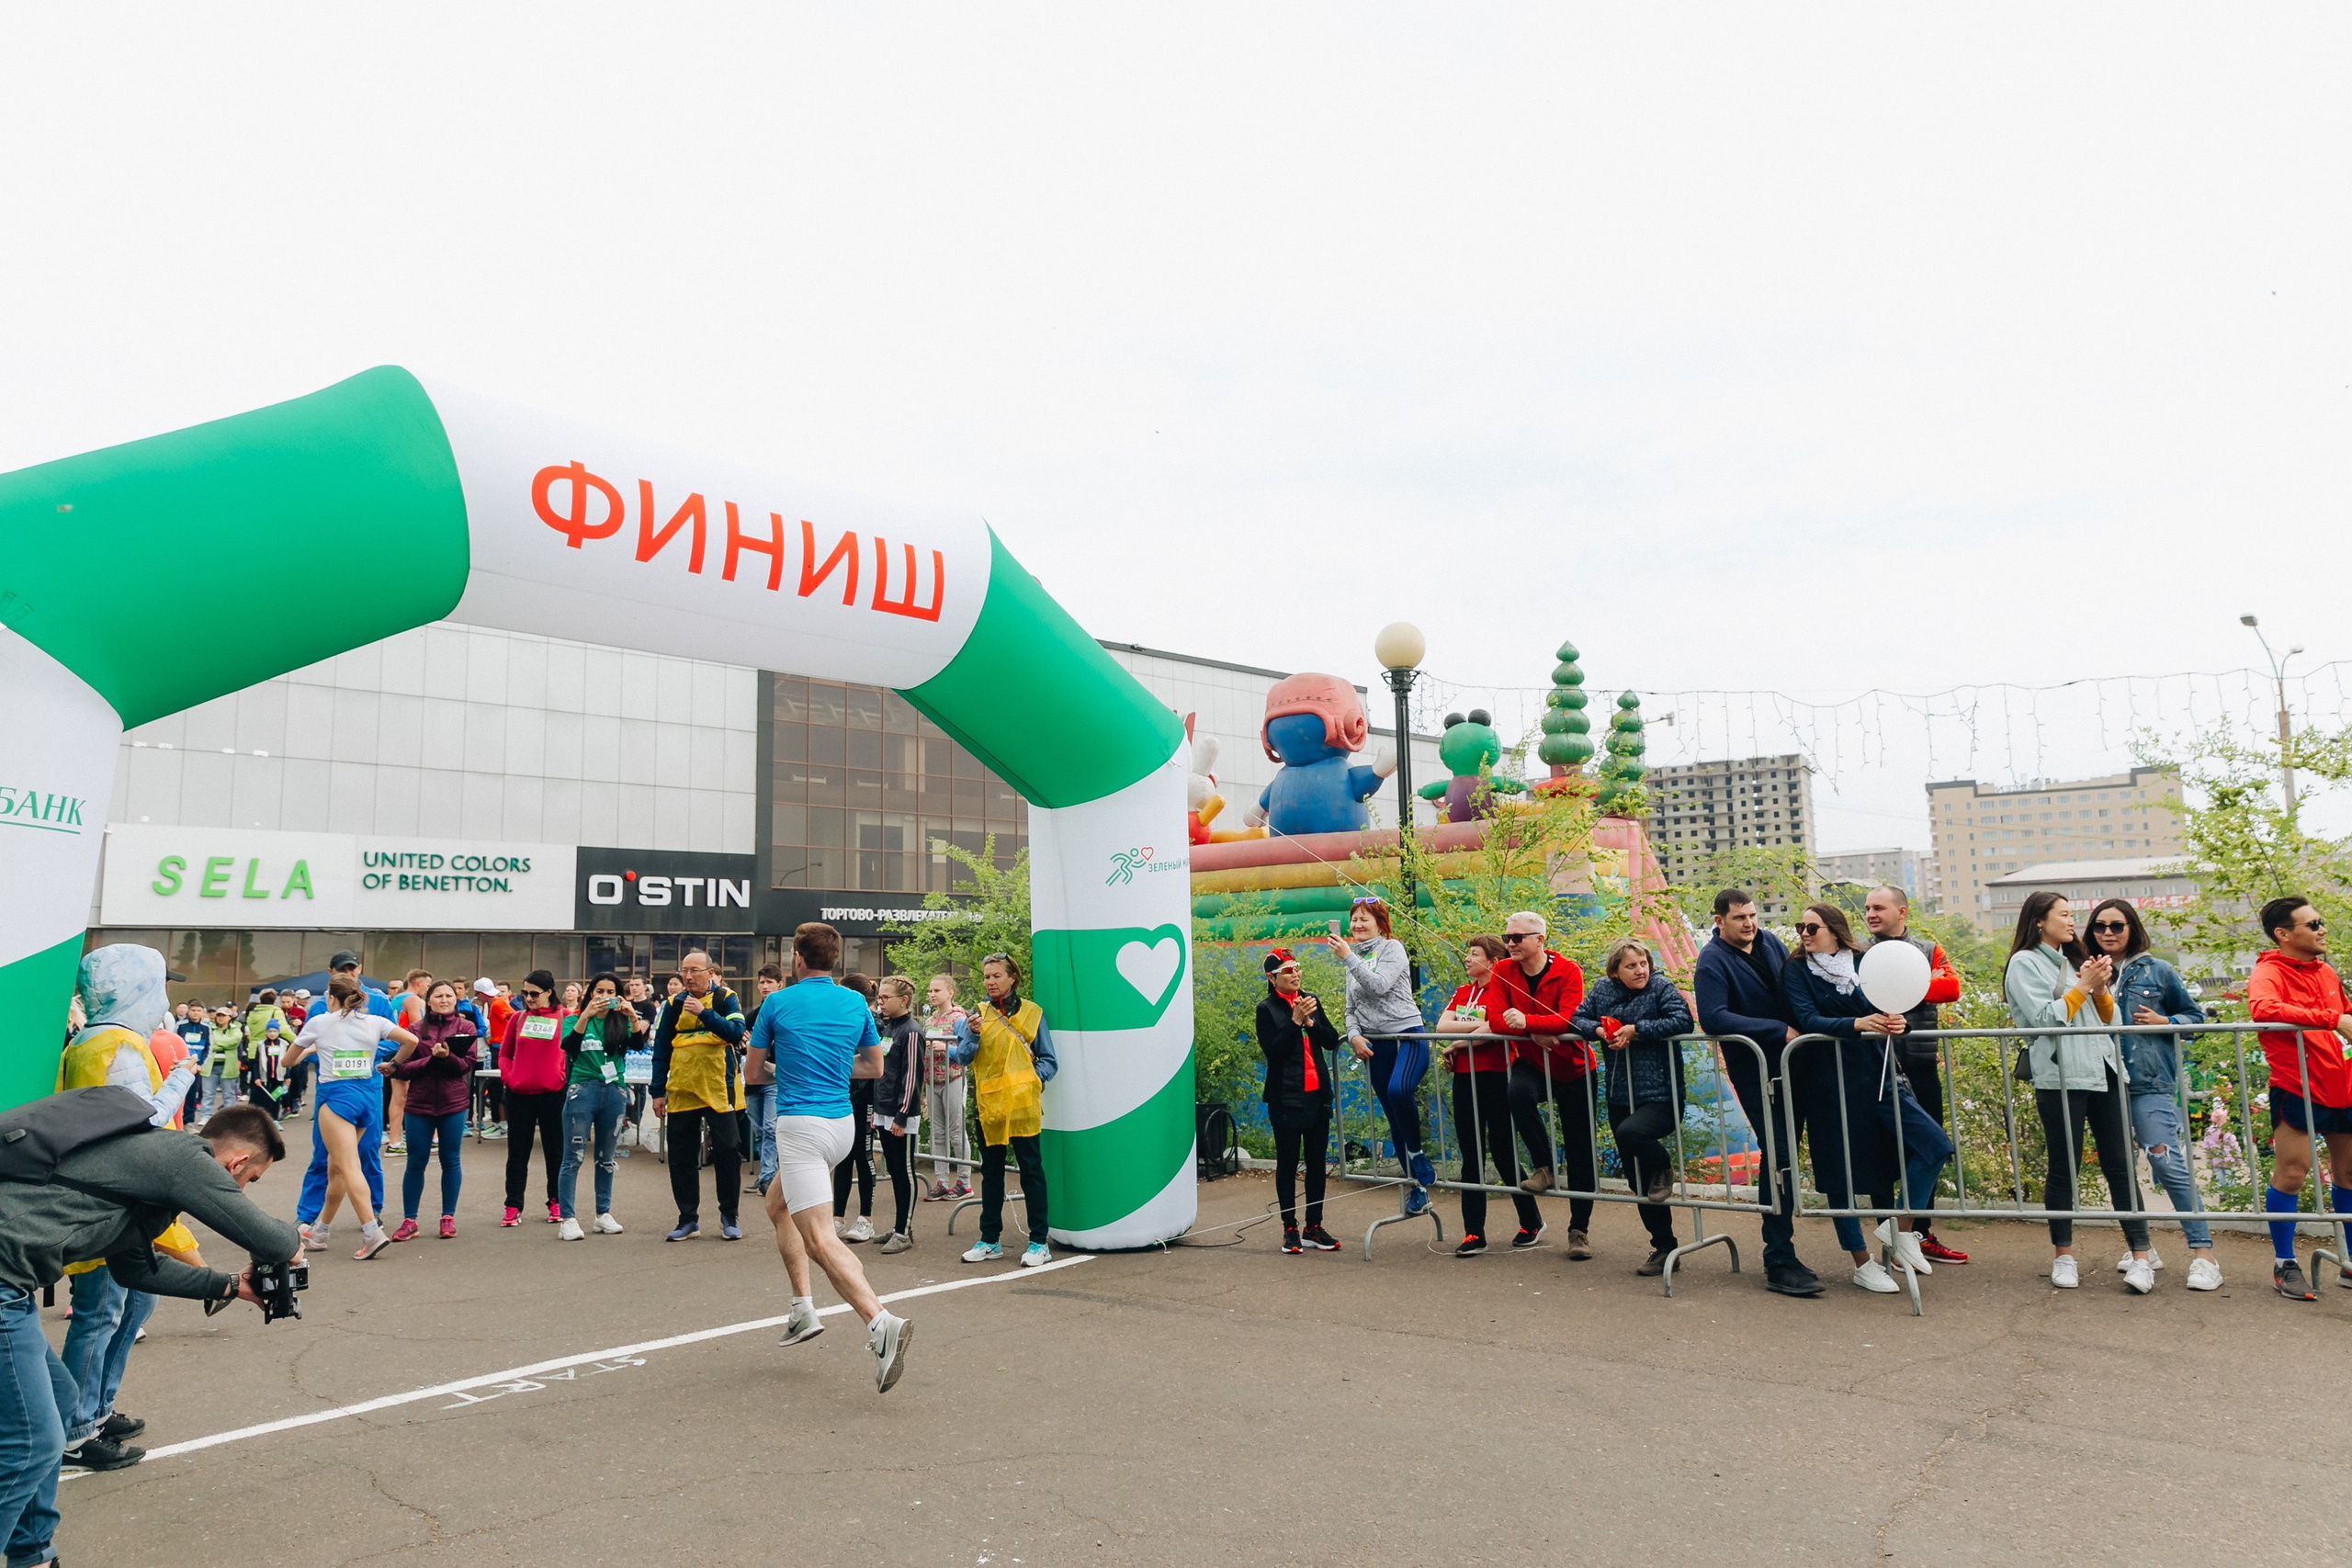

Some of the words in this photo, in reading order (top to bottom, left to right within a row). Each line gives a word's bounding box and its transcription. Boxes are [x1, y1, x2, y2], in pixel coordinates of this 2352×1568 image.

[531, 459, 945, 622] ФИНИШ
[364, 852, 444, 869] UNITED
[451, 855, 531, 873] COLORS
[1148, 858, 1182, 873] ЗЕЛЕНЫЙ
[152, 855, 314, 899] SELA
[363, 874, 392, 889] OF
[399, 874, 514, 893] BENETTON.
[345, 1059, 367, 1068] 0191
